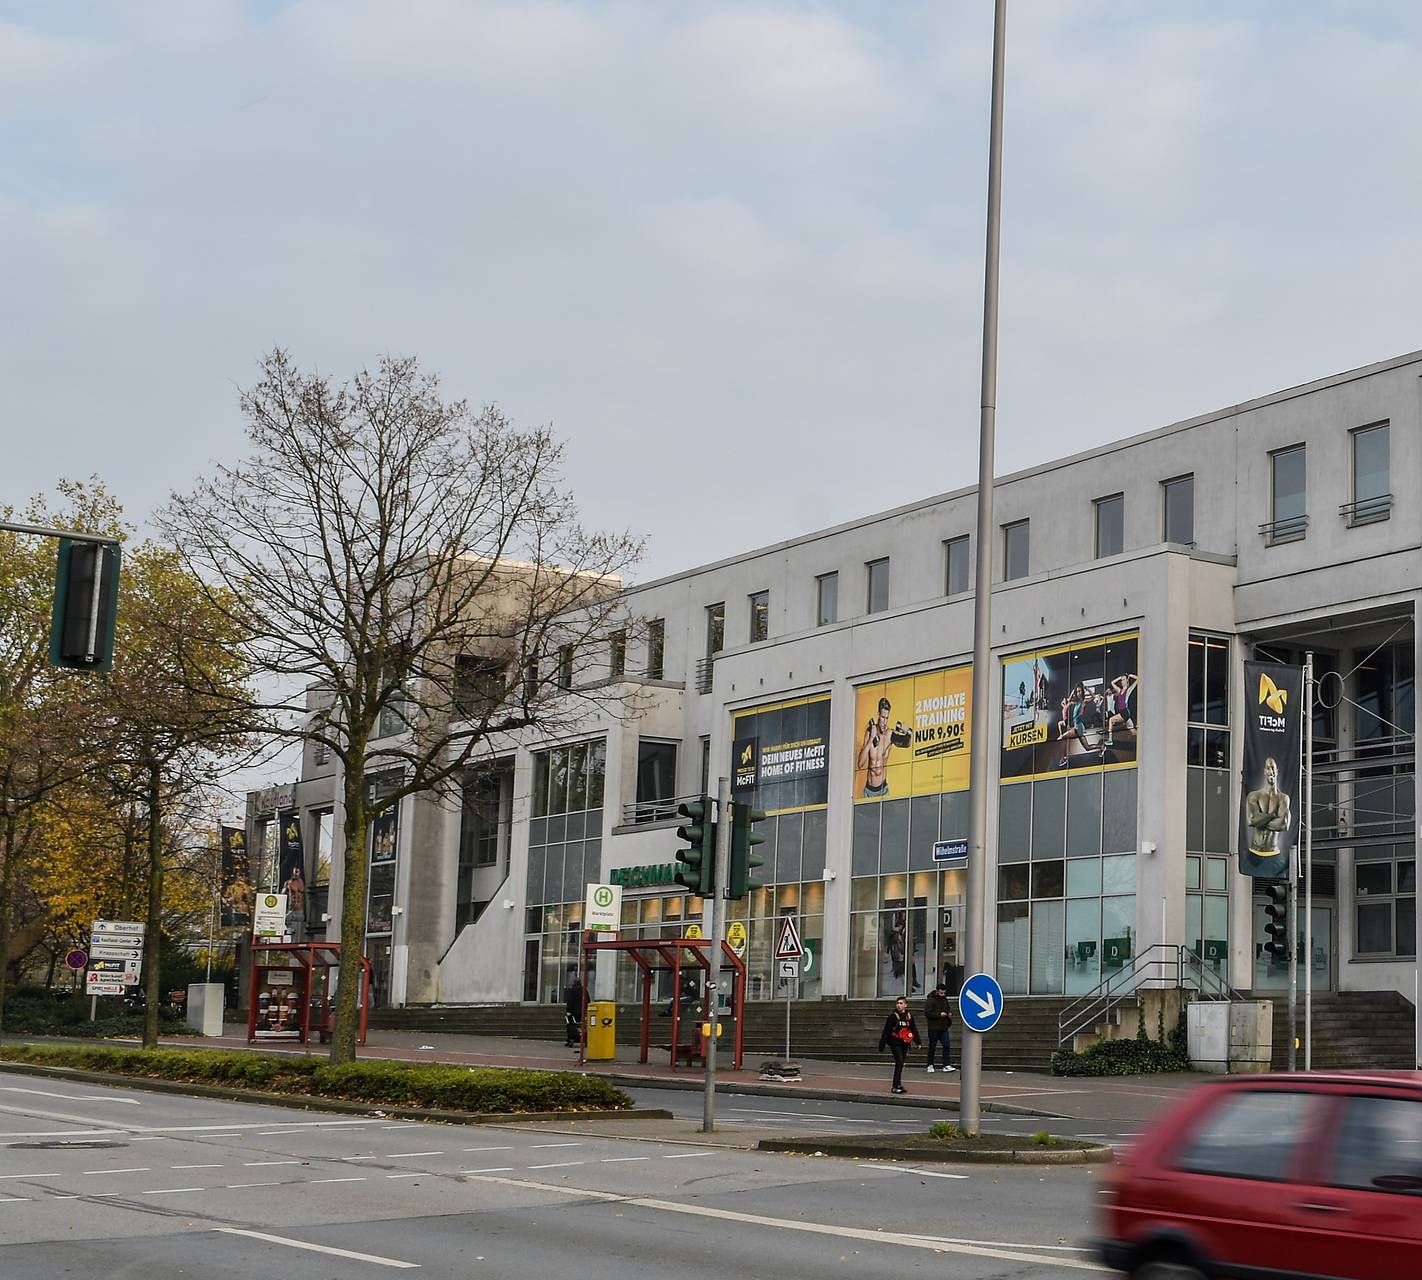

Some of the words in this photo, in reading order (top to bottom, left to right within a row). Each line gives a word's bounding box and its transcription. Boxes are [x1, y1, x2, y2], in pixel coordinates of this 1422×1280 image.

[915, 699, 922, 713] 2
[923, 692, 966, 712] MONATE
[915, 707, 966, 728] TRAINING
[915, 728, 935, 743] NUR
[937, 723, 965, 739] 9,90€
[1010, 728, 1044, 748] KURSEN
[762, 752, 779, 766] DEIN
[780, 748, 803, 762] NEUES
[803, 744, 826, 759] McFIT
[761, 763, 783, 777] HOME
[784, 761, 795, 774] OF
[795, 757, 825, 772] FITNESS
[736, 774, 755, 786] McFIT
[1111, 946, 1118, 957] D
[1209, 946, 1217, 957] D
